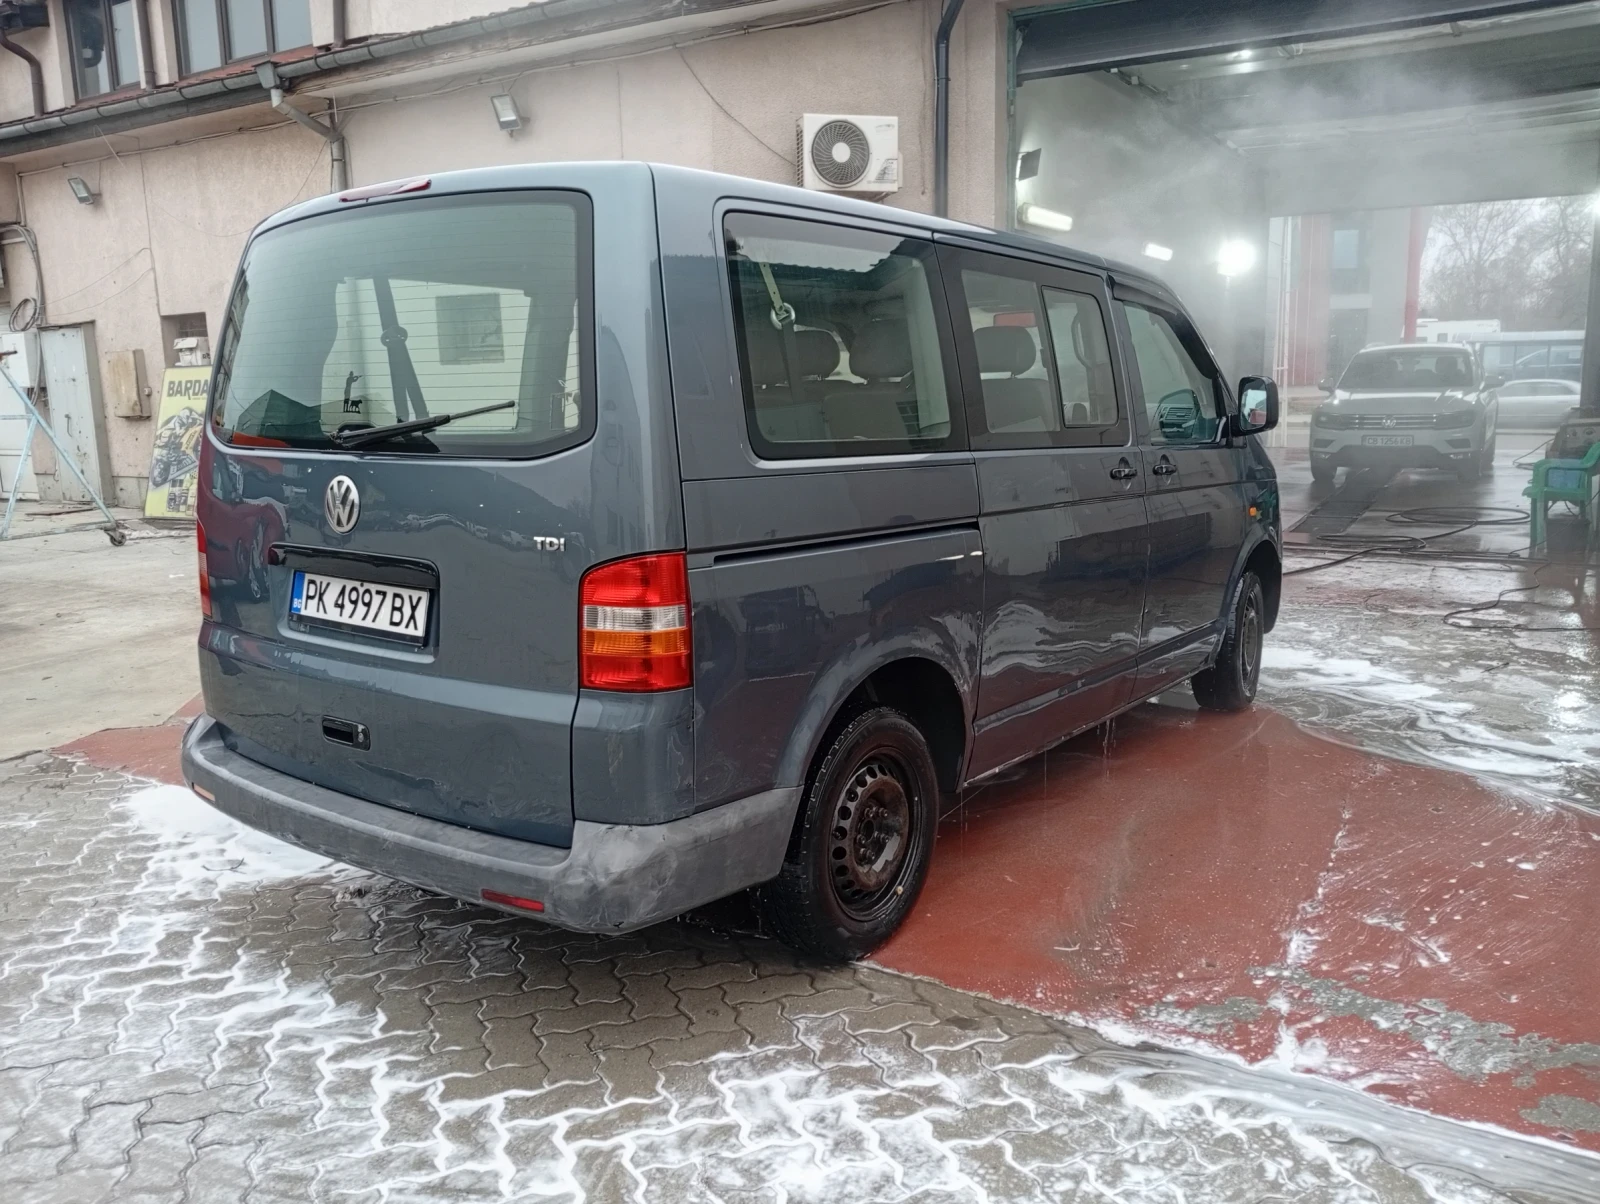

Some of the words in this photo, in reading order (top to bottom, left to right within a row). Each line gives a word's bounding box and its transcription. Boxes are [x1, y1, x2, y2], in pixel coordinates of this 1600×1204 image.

[533, 536, 565, 552] TDI
[304, 578, 331, 615] PK
[333, 584, 387, 623] 4997
[389, 592, 422, 631] BX
